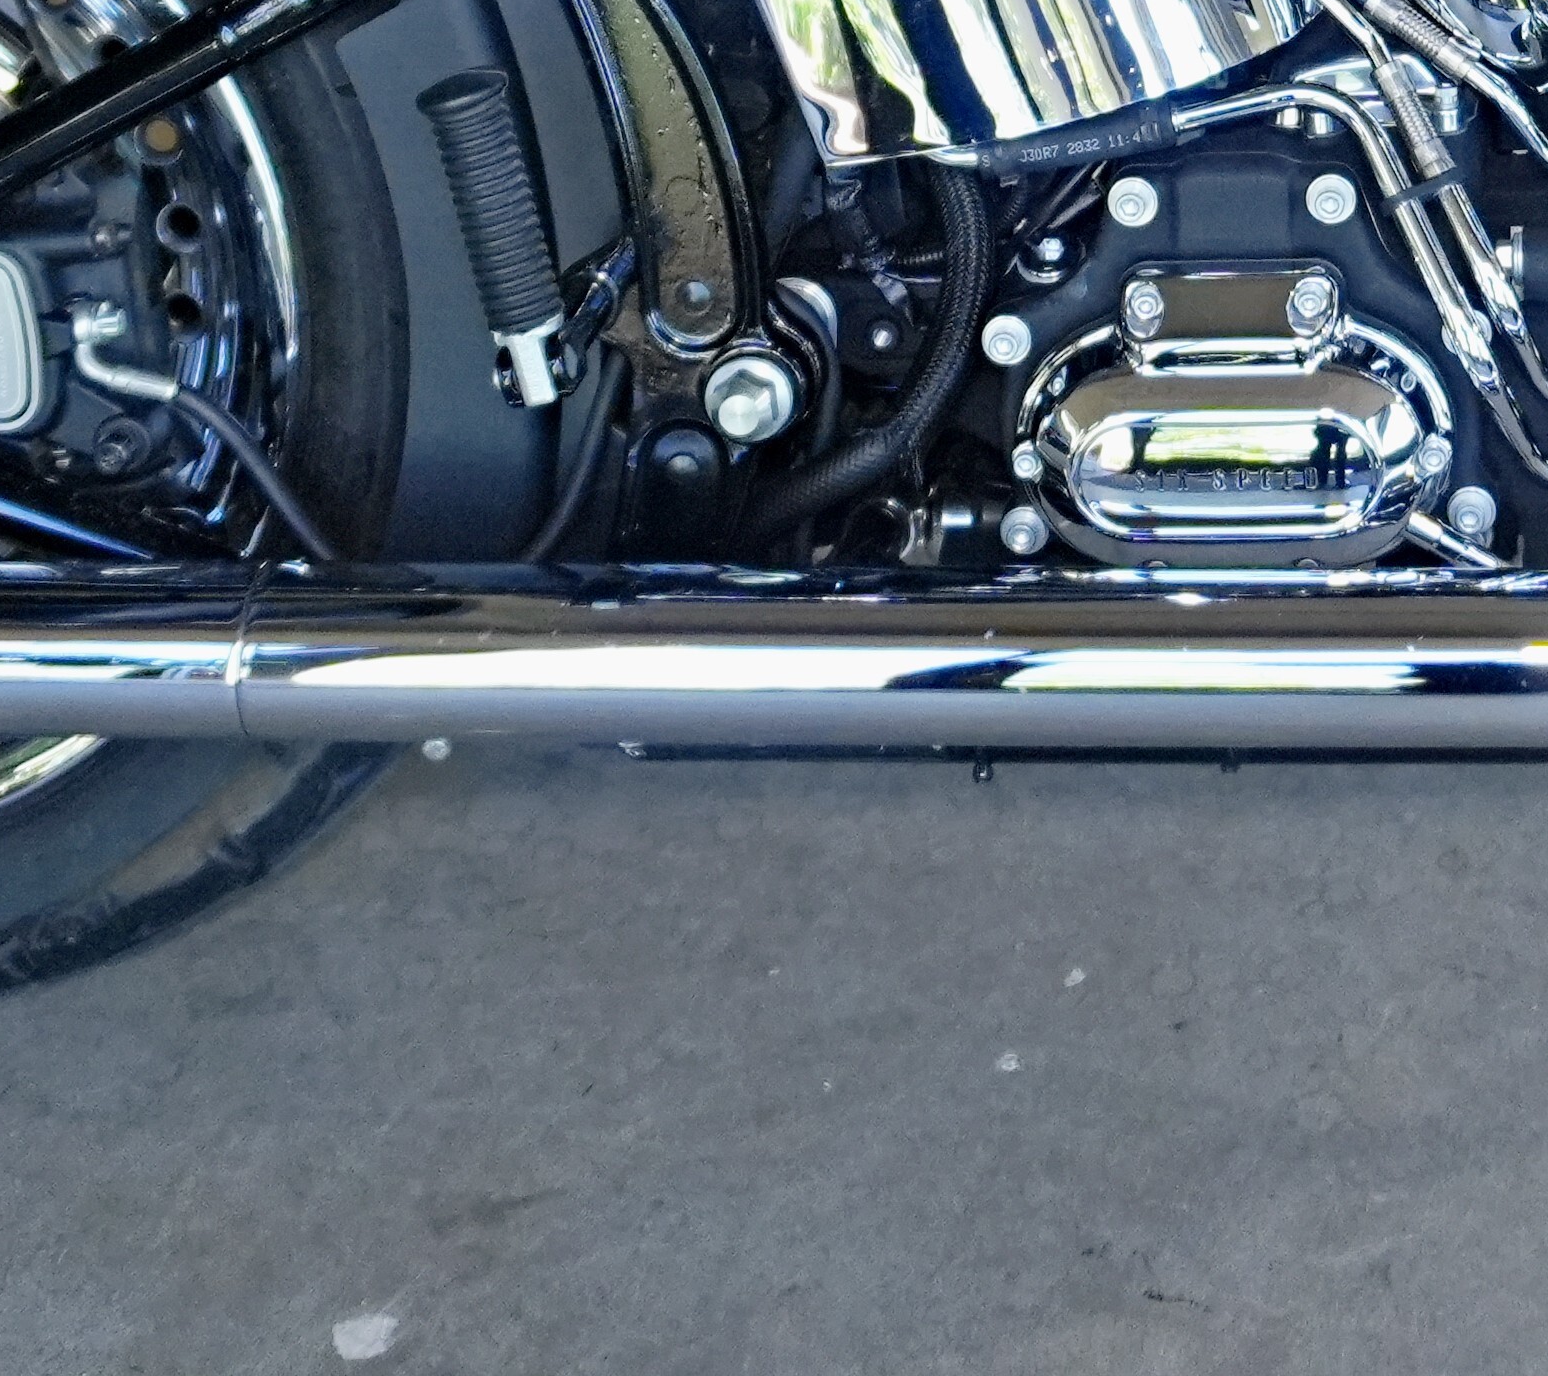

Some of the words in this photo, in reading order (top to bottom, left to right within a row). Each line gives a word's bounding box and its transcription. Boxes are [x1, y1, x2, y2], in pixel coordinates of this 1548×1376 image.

[1108, 130, 1142, 148] 11:4
[1134, 467, 1189, 493] SIX
[1211, 466, 1319, 492] SPEED
